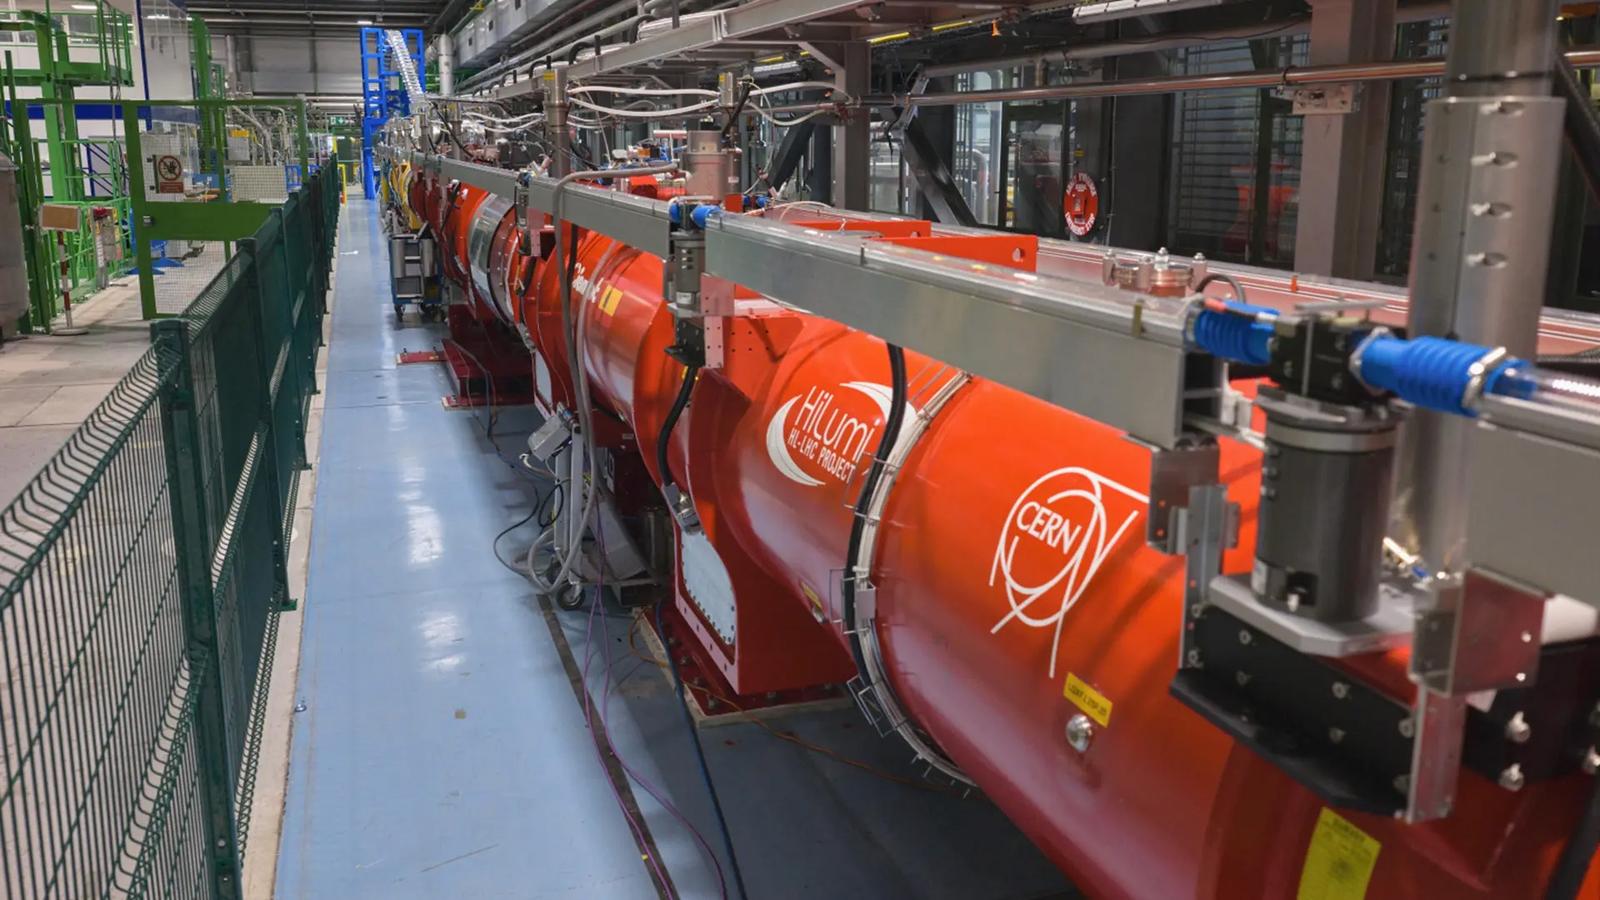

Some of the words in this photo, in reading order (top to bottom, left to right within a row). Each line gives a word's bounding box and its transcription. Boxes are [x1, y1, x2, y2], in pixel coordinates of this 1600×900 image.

[794, 385, 880, 464] HiLumi
[787, 427, 819, 460] HL-LHC
[817, 446, 856, 484] PROJECT
[1016, 501, 1082, 554] CERN
